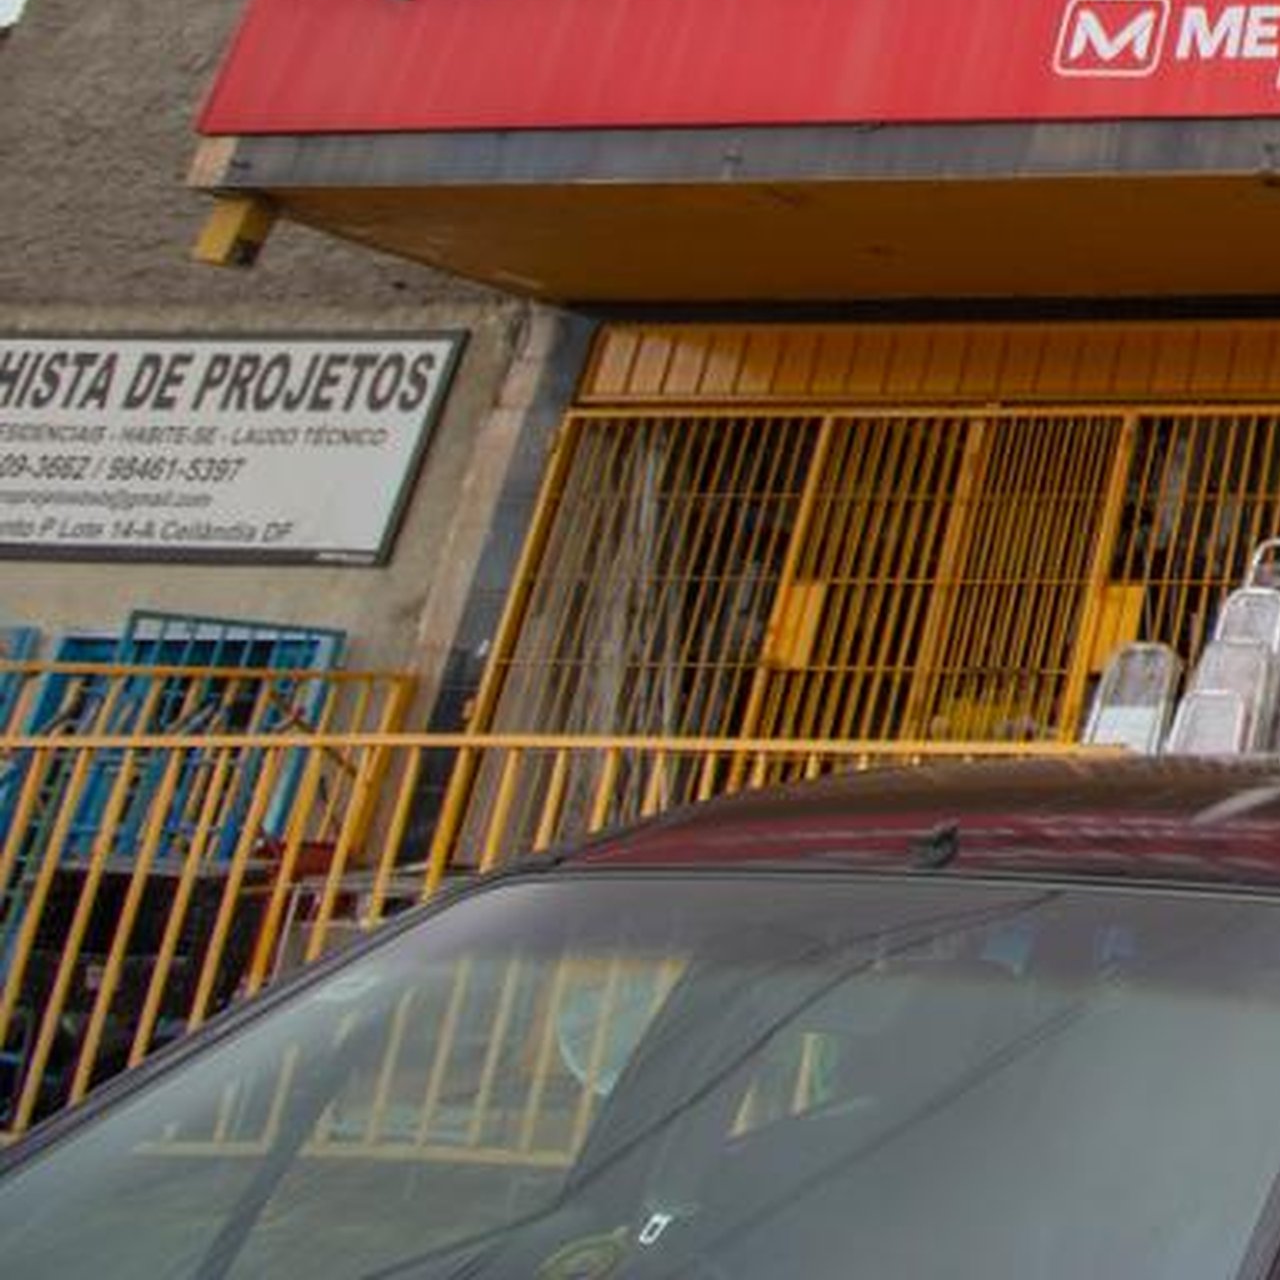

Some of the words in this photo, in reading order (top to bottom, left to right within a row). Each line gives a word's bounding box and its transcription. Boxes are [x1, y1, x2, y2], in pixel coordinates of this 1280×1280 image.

[121, 352, 195, 411] DE
[190, 353, 437, 412] PROJETOS
[303, 424, 389, 448] TÉCNICO
